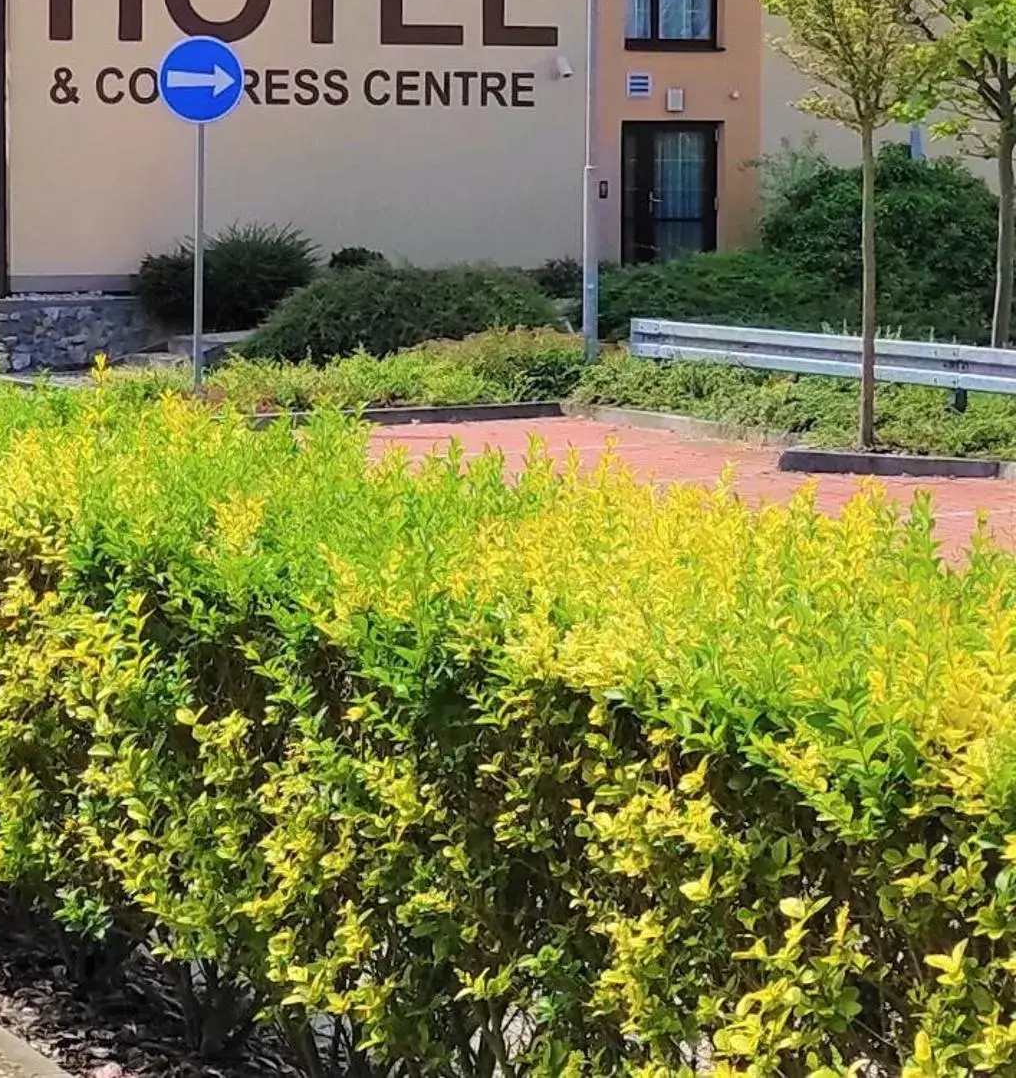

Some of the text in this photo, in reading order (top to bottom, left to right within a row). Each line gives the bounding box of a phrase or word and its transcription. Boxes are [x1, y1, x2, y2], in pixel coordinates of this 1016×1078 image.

[50, 68, 535, 107] & CORESS CENTRE
